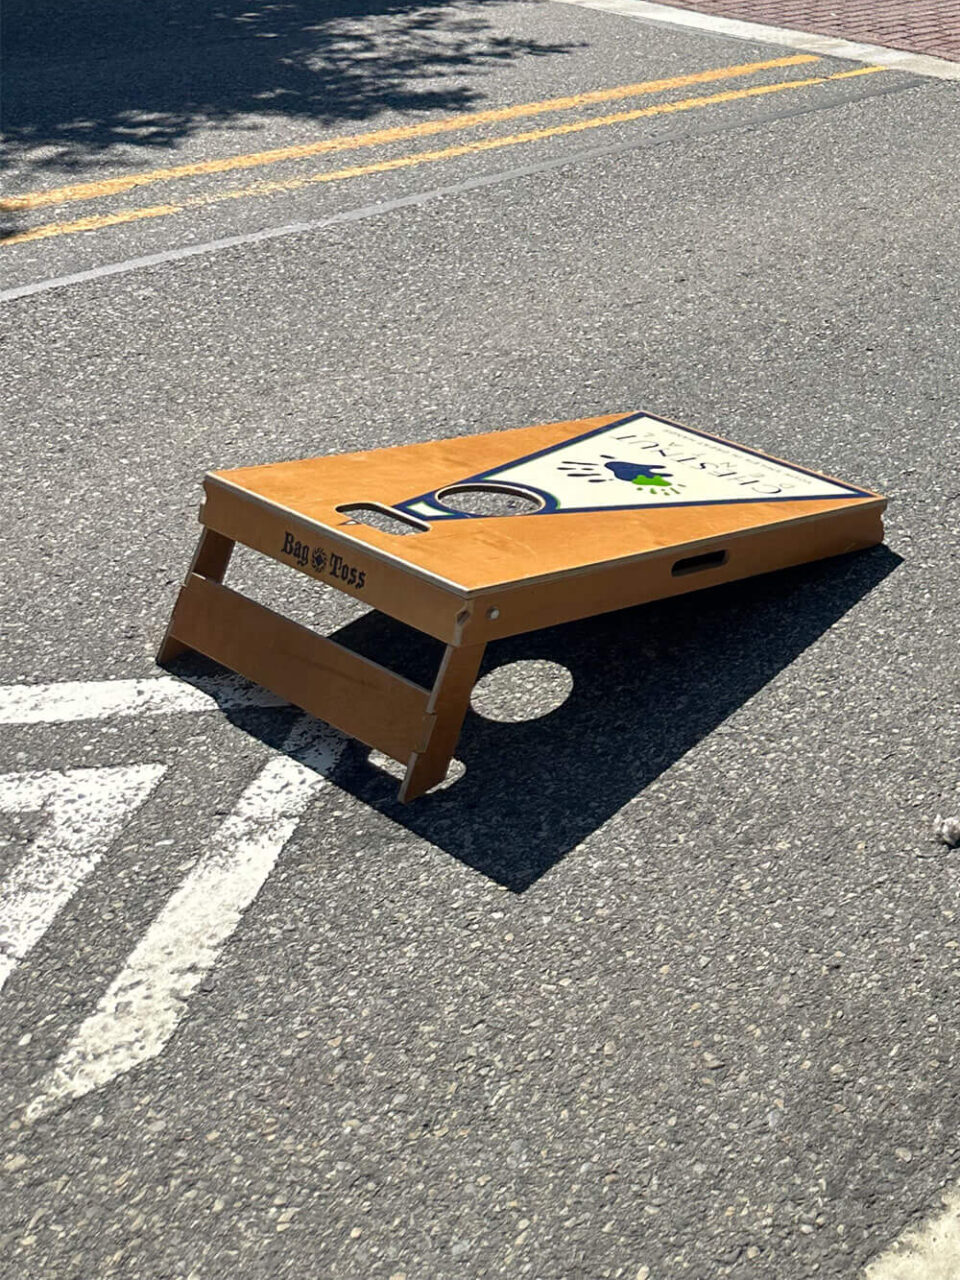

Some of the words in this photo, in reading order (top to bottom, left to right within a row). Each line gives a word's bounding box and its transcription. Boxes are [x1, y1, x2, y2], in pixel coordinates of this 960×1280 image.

[611, 433, 783, 495] CHESTNUT
[280, 531, 310, 567] Bag
[329, 552, 366, 590] Toss
